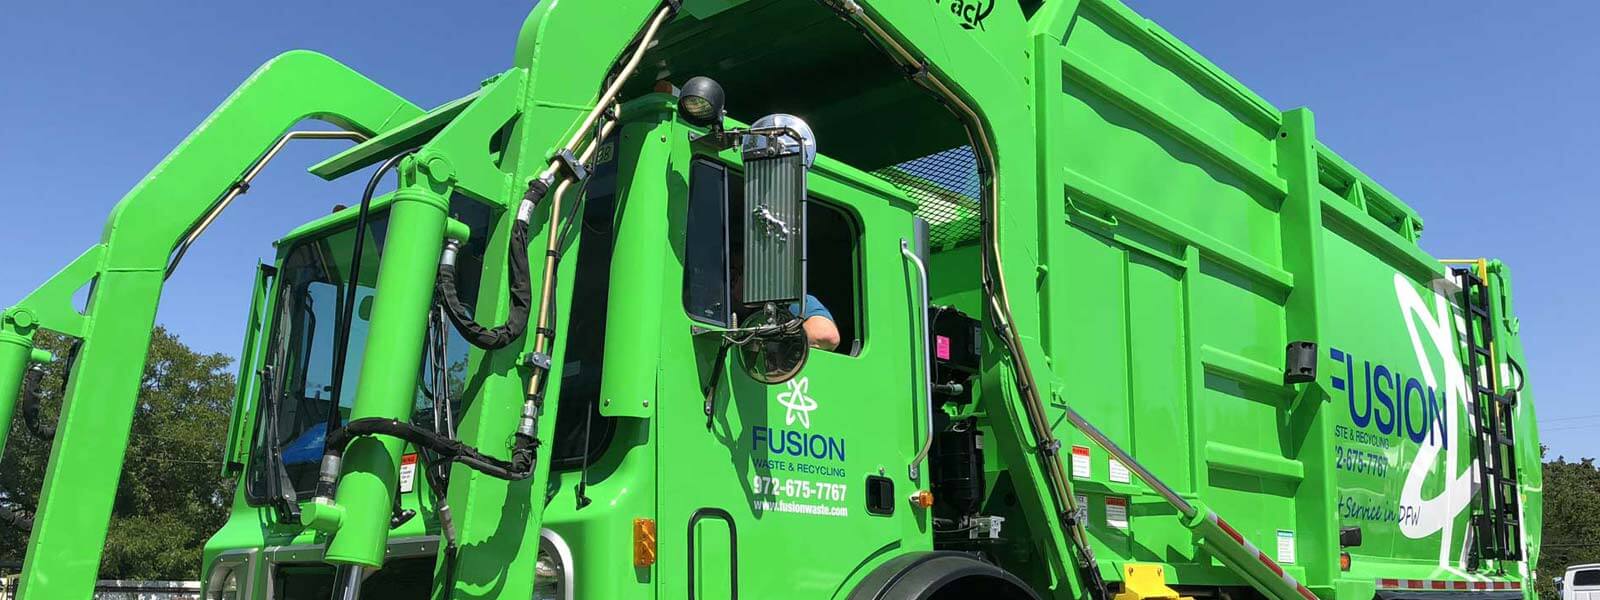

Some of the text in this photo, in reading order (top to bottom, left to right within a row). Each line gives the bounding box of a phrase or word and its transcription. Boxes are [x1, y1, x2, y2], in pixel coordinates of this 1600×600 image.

[752, 425, 845, 462] FUSION
[1335, 425, 1348, 440] STE
[1355, 430, 1390, 450] RECYCLING
[753, 457, 846, 478] WASTE & RECYCLING
[1335, 445, 1389, 478] 2-675-7767
[753, 475, 848, 501] 972-675-7767
[753, 499, 849, 517] www.fusionwaste.com
[1344, 496, 1382, 521] Service
[1383, 500, 1397, 522] in
[1397, 505, 1421, 526] DFW
